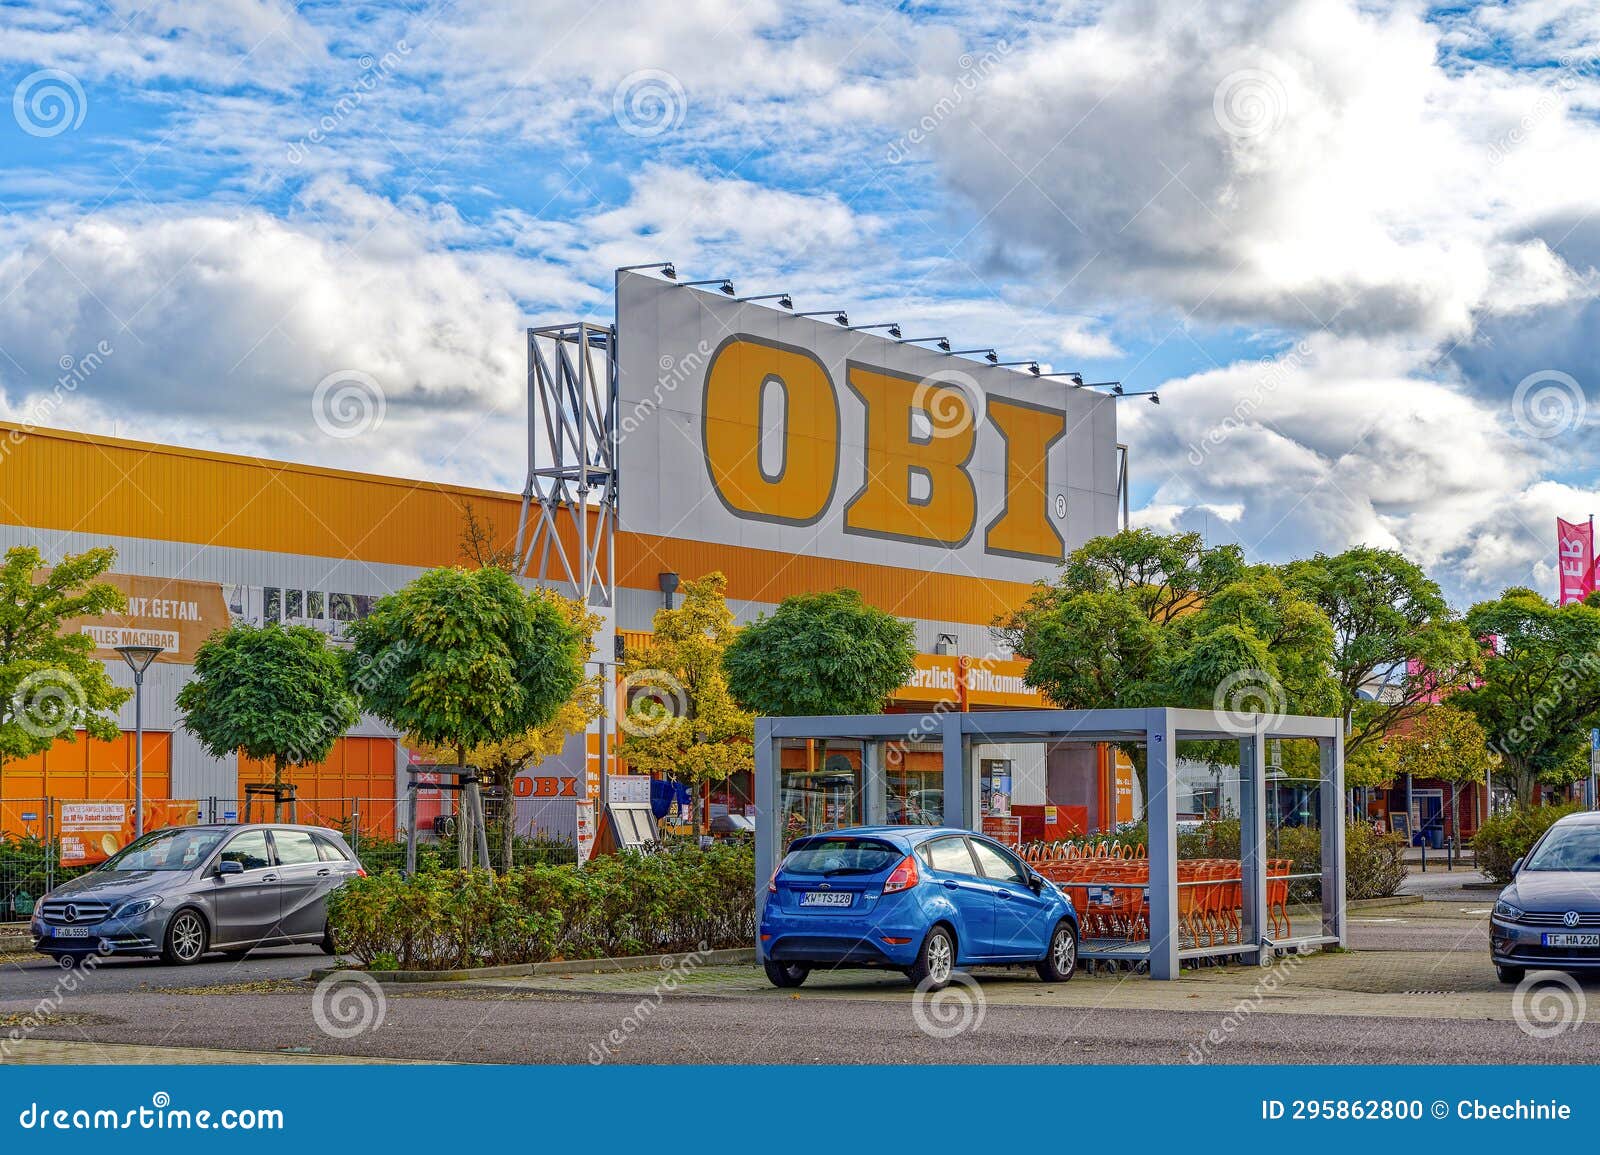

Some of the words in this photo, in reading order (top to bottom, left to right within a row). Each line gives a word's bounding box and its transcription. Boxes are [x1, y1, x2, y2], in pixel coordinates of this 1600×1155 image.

[702, 333, 1066, 563] OBI
[102, 597, 202, 621] NT.GETAN.
[88, 629, 118, 645] ALLES
[121, 631, 174, 648] MACHBAR
[514, 777, 577, 797] OBI
[834, 894, 851, 904] 128
[1548, 935, 1560, 945] TF
[1565, 935, 1579, 945] HA
[1581, 935, 1598, 945] 226
